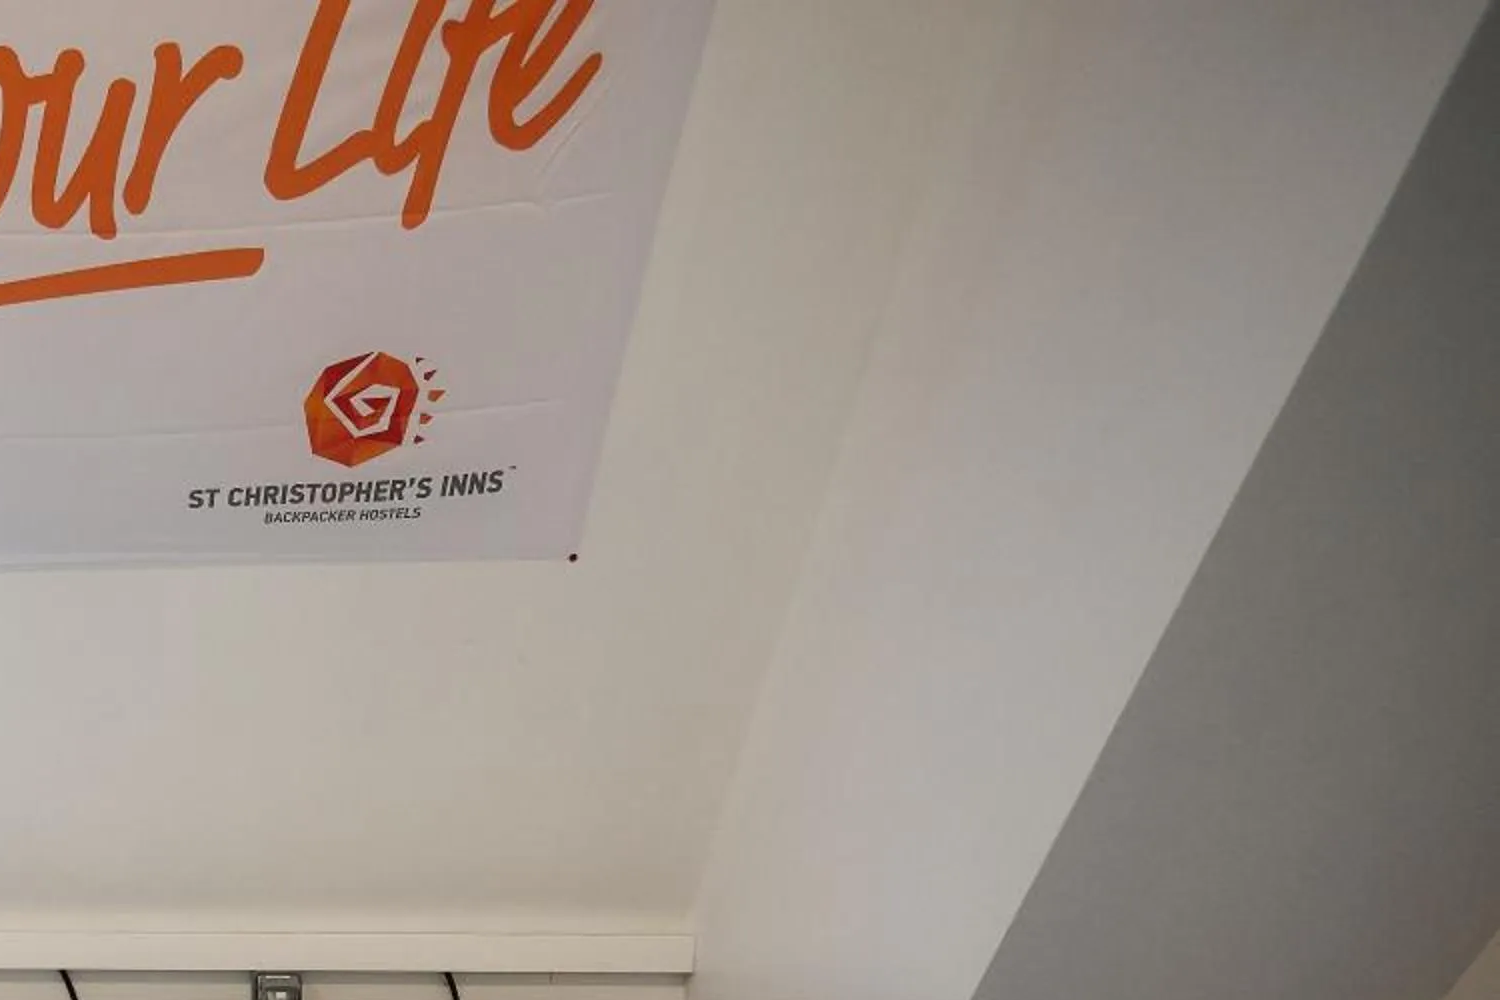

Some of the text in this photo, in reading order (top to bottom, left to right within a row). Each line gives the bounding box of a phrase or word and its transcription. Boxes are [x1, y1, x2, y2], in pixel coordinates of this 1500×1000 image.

[263, 0, 603, 230] Life
[188, 470, 504, 509] ST CHRISTOPHER'S INNS
[263, 507, 421, 525] BACKPACKER HOSTELS
